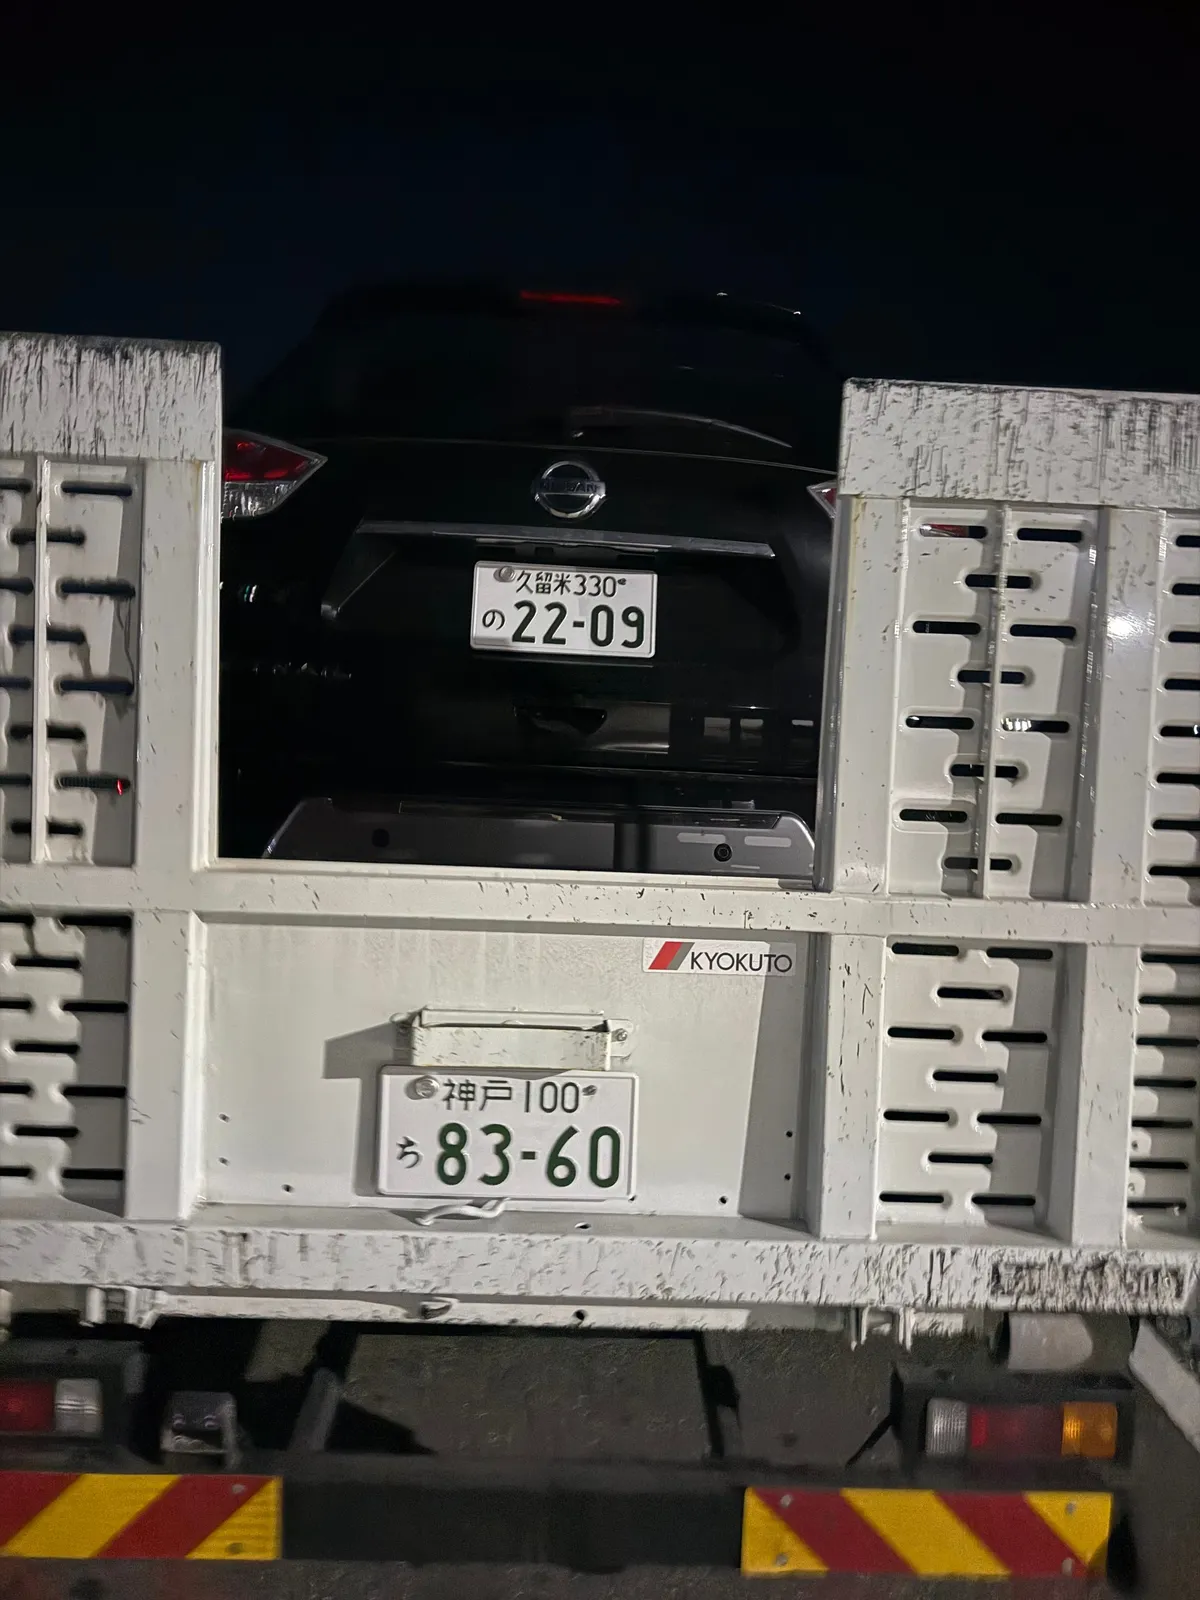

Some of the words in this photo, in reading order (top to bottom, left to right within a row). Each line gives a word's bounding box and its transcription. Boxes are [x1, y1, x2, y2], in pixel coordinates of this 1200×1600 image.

[482, 609, 505, 630] の
[511, 600, 645, 648] 22-09
[690, 952, 792, 973] KYOKUTO
[437, 1122, 620, 1187] 83-60
